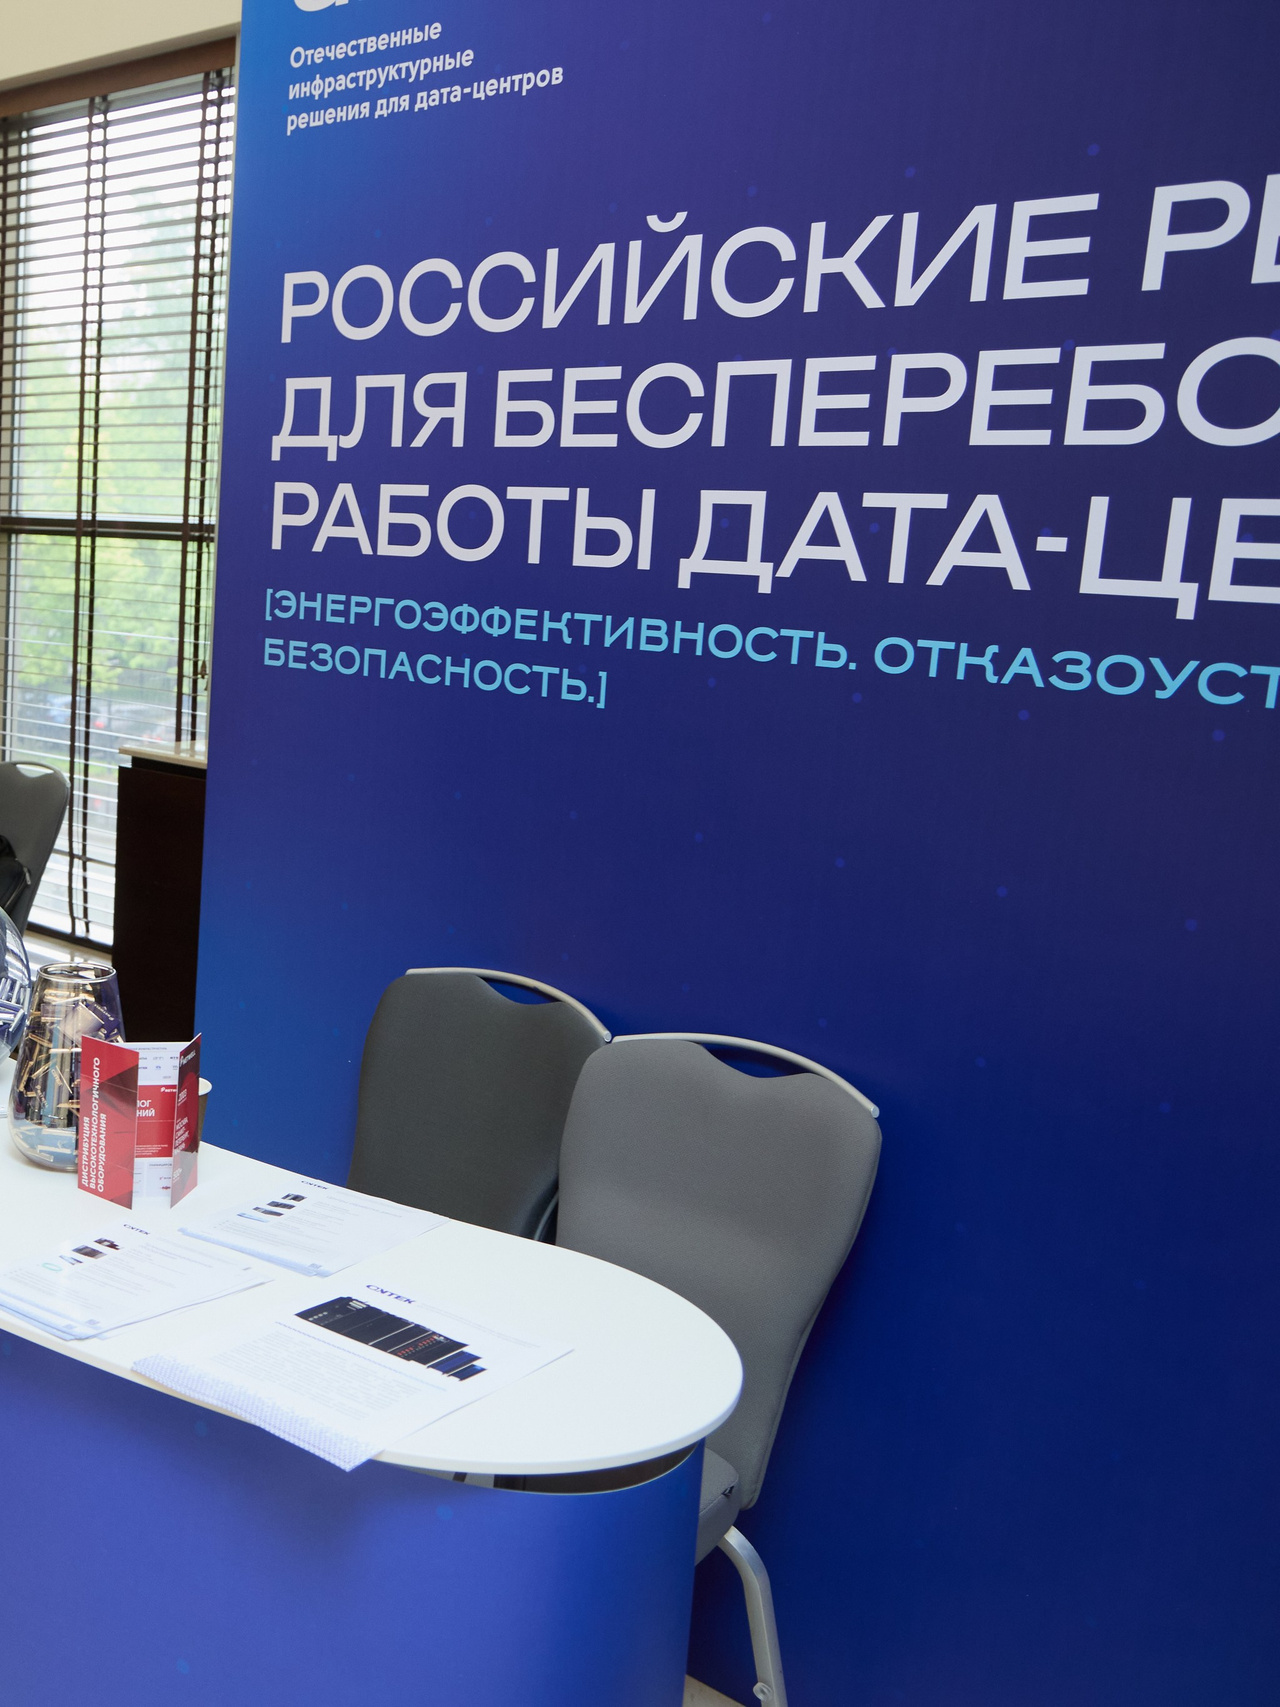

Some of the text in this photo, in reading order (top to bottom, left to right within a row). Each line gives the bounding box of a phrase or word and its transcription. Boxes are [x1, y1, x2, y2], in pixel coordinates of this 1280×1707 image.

[288, 49, 474, 100] инфраструктурные
[289, 22, 442, 68] Отечественные
[286, 66, 564, 136] решения для дата-центров
[281, 172, 1280, 343] РОССИЙСКИЕ Р
[271, 336, 1280, 461] ДЛЯ БЕСПЕРЕБО
[270, 481, 1280, 620] РАБОТЫ ДАТА-ЦЕ
[265, 587, 857, 670] [ЭНЕРГОЭФФЕКТИВНОСТЬ.
[263, 637, 607, 709] БЕЗОПАСНОСТЬ.]
[81, 1116, 90, 1188] ДИСТРИБУЦИЯ
[89, 1057, 101, 1190] ВЫСОКОТЕХНОЛОГИЧНОГО
[97, 1113, 107, 1193] ОБОРУДОВАНИЯ
